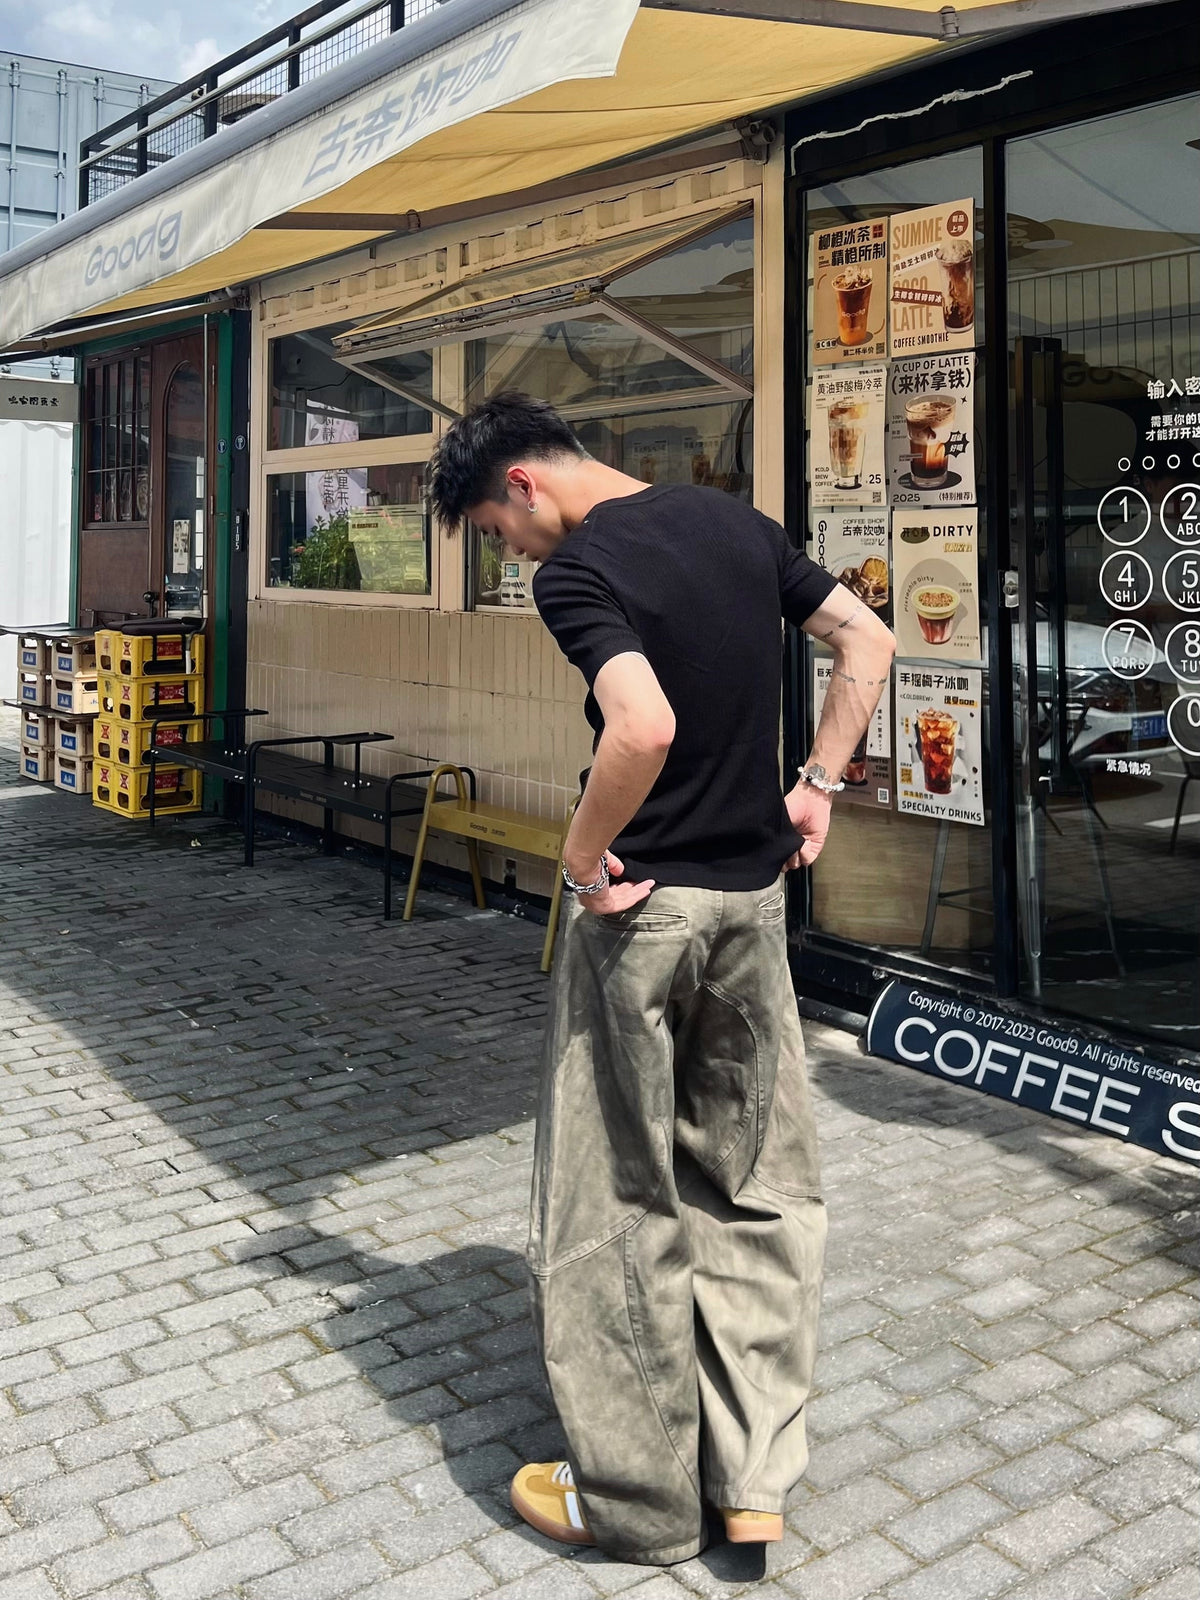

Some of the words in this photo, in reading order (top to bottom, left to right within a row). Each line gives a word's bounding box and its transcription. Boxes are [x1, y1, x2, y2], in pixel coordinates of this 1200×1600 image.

[818, 225, 871, 251] 柳橙冰茶
[893, 216, 944, 250] SUMME
[893, 305, 934, 333] LATTE
[893, 337, 916, 349] COFFEE
[917, 332, 949, 346] SMOOTHIE
[894, 364, 900, 373] A
[903, 362, 921, 373] CUP
[923, 360, 936, 370] OF
[939, 355, 969, 368] LATTE
[1150, 412, 1200, 428] 需要你的
[893, 494, 921, 503] 2025
[1119, 496, 1128, 523] 1
[1181, 491, 1198, 520] 2
[933, 525, 974, 537] DIRTY
[1117, 560, 1135, 588] 4
[1182, 560, 1199, 588] 5
[1114, 590, 1137, 603] GHI
[1120, 627, 1136, 654] 7
[1185, 629, 1200, 658] 8
[1112, 656, 1145, 670] PQRS
[1180, 660, 1200, 673] TU
[1106, 759, 1152, 776] 紧急情况
[901, 800, 946, 815] SPECIALTY
[948, 807, 982, 822] DRINKS
[908, 990, 962, 1019] Copyright
[975, 1011, 1036, 1041] 2017-2023
[1081, 1043, 1101, 1062] All
[1101, 1050, 1141, 1072] rights
[894, 1016, 1141, 1136] COFFEE
